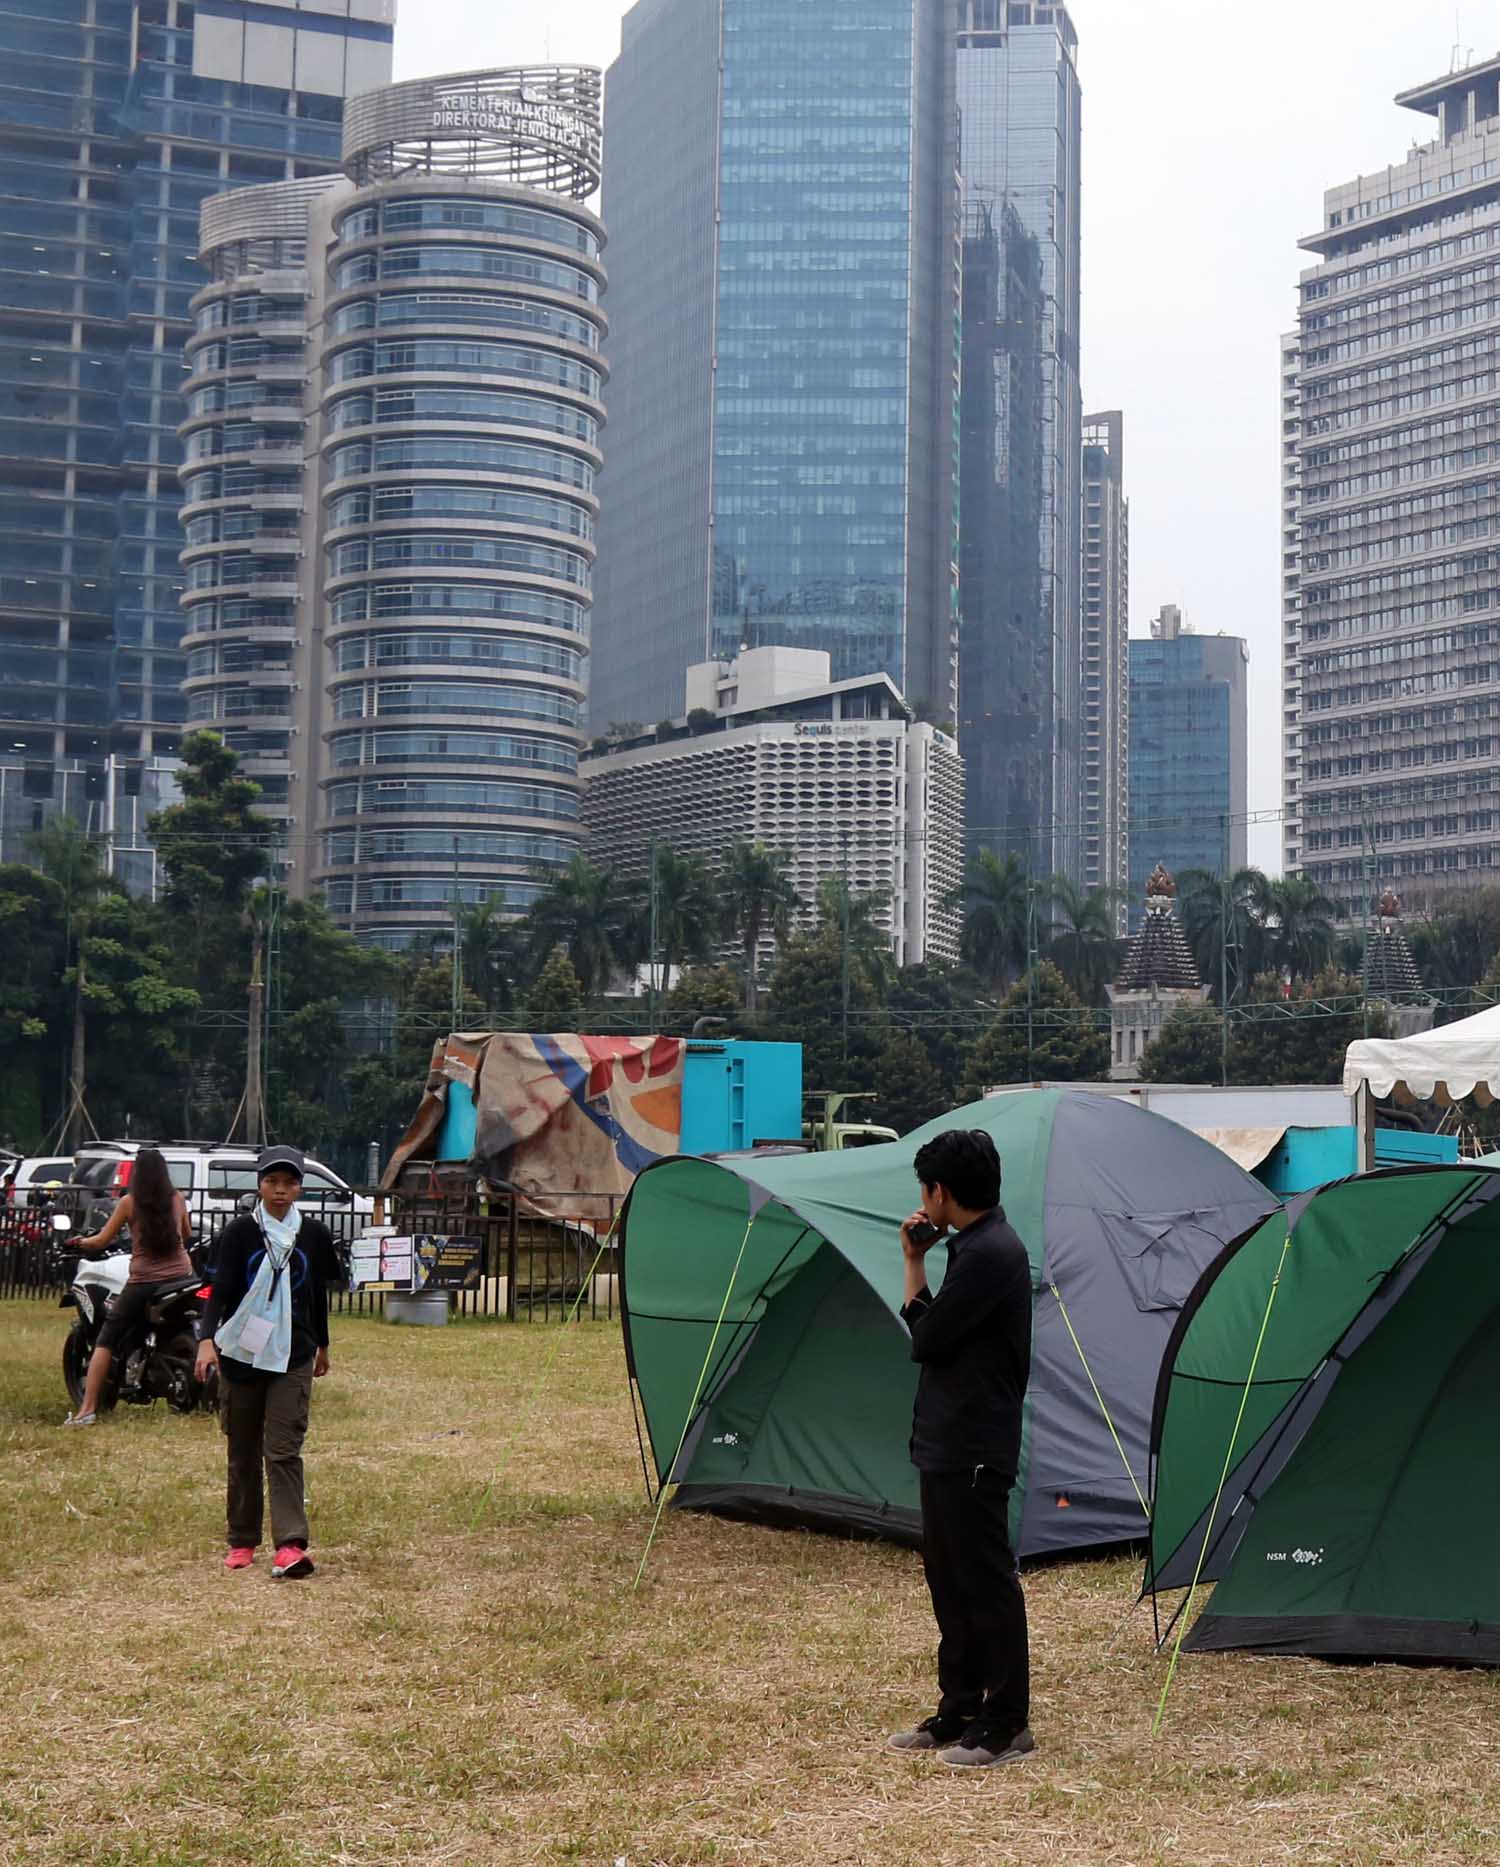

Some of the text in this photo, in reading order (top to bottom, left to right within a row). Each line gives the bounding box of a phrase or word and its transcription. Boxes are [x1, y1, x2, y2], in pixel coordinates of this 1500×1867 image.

[442, 95, 534, 117] KEMENTERIAN
[534, 106, 586, 137] KEUANGAN
[433, 111, 512, 129] DIREKTORAT
[514, 118, 570, 146] JENDERAL
[793, 723, 833, 737] Sequis
[1266, 1552, 1287, 1561] NSM
